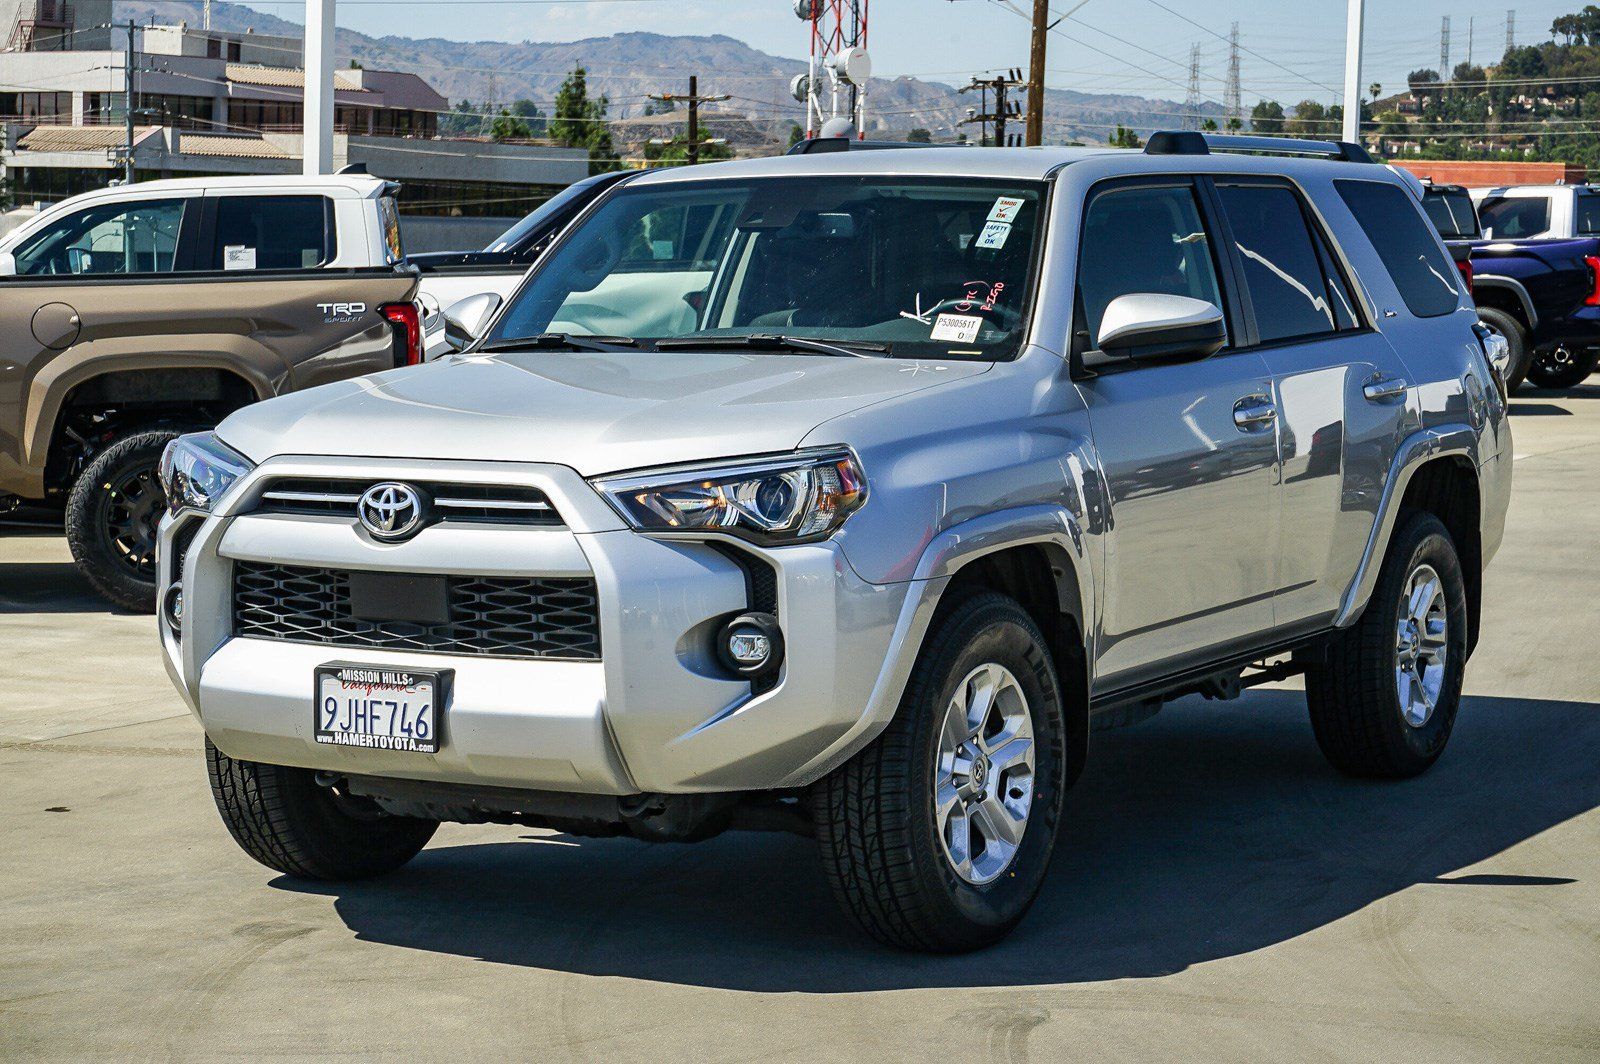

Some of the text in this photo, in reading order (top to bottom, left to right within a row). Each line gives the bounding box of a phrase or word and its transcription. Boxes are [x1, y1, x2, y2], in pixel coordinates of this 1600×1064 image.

[316, 302, 366, 316] TRD
[342, 669, 409, 686] MISSION HILLS
[324, 697, 430, 738] 9JHF746
[316, 731, 434, 753] www.HAMERTOYOTA.com
